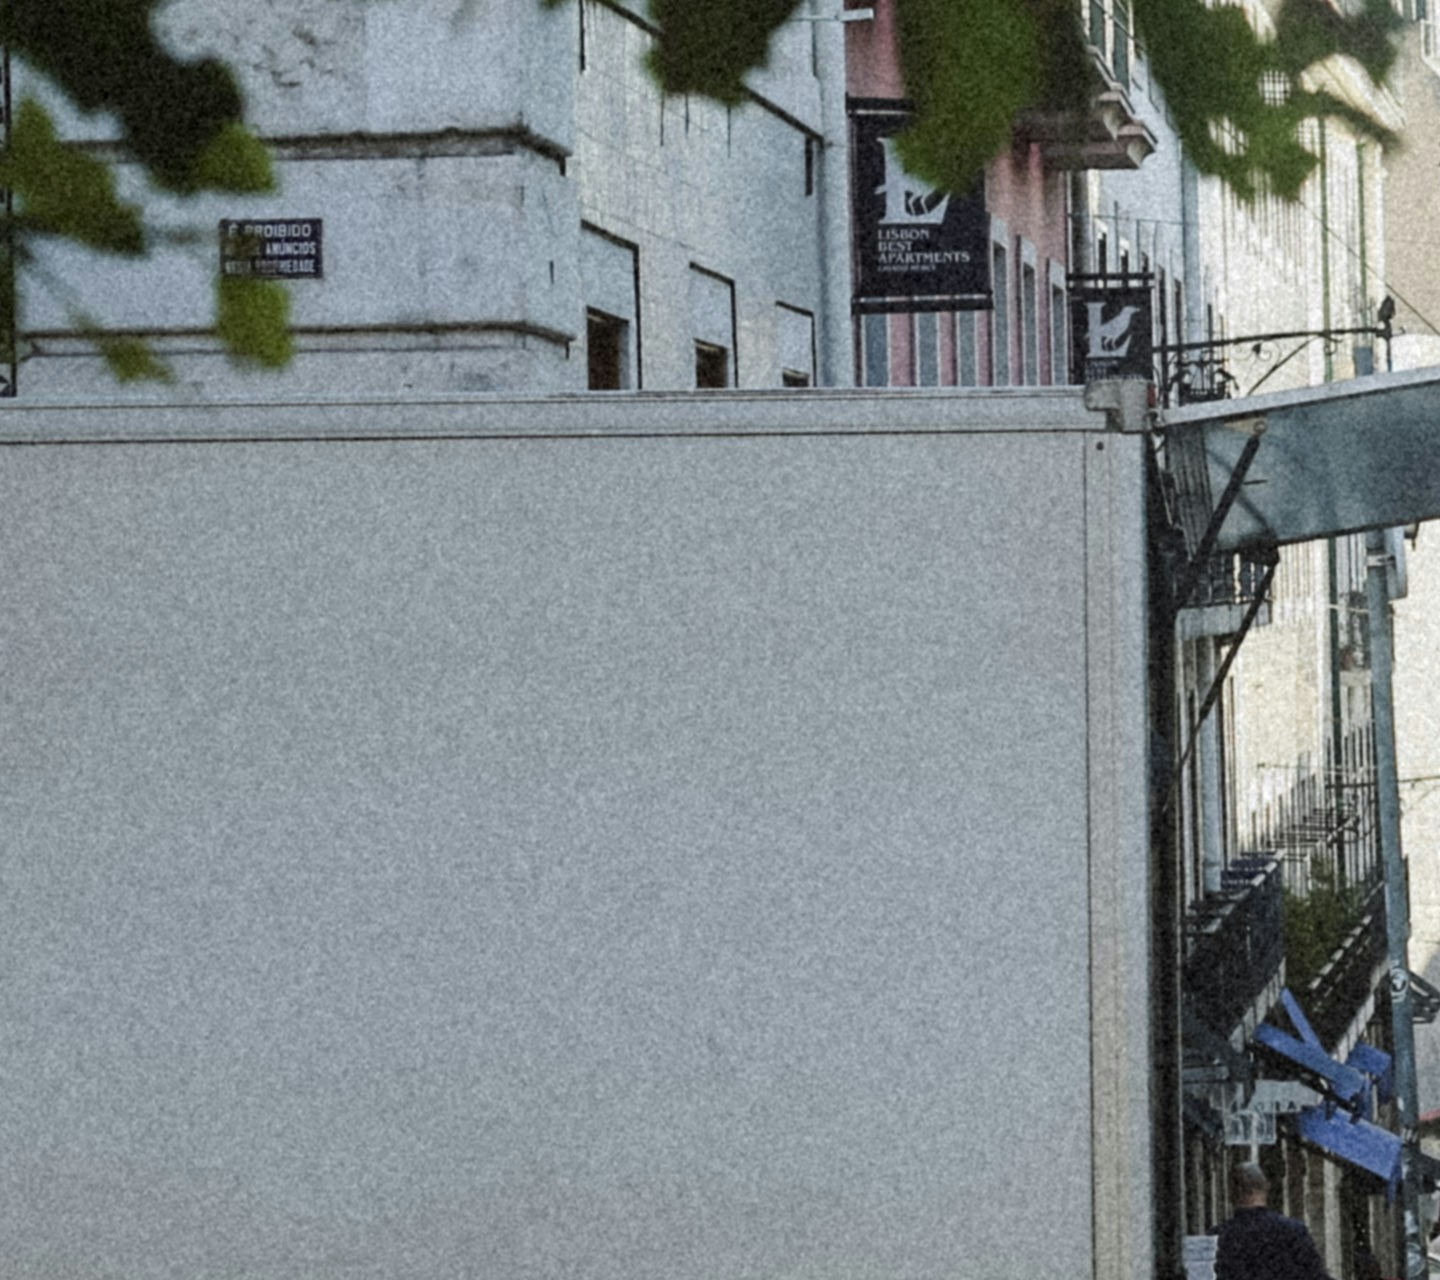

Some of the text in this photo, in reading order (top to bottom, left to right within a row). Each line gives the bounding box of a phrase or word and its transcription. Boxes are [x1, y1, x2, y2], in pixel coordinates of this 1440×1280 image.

[878, 229, 930, 240] LISBON
[878, 241, 913, 252] BEST
[878, 252, 971, 265] APARTMENTS
